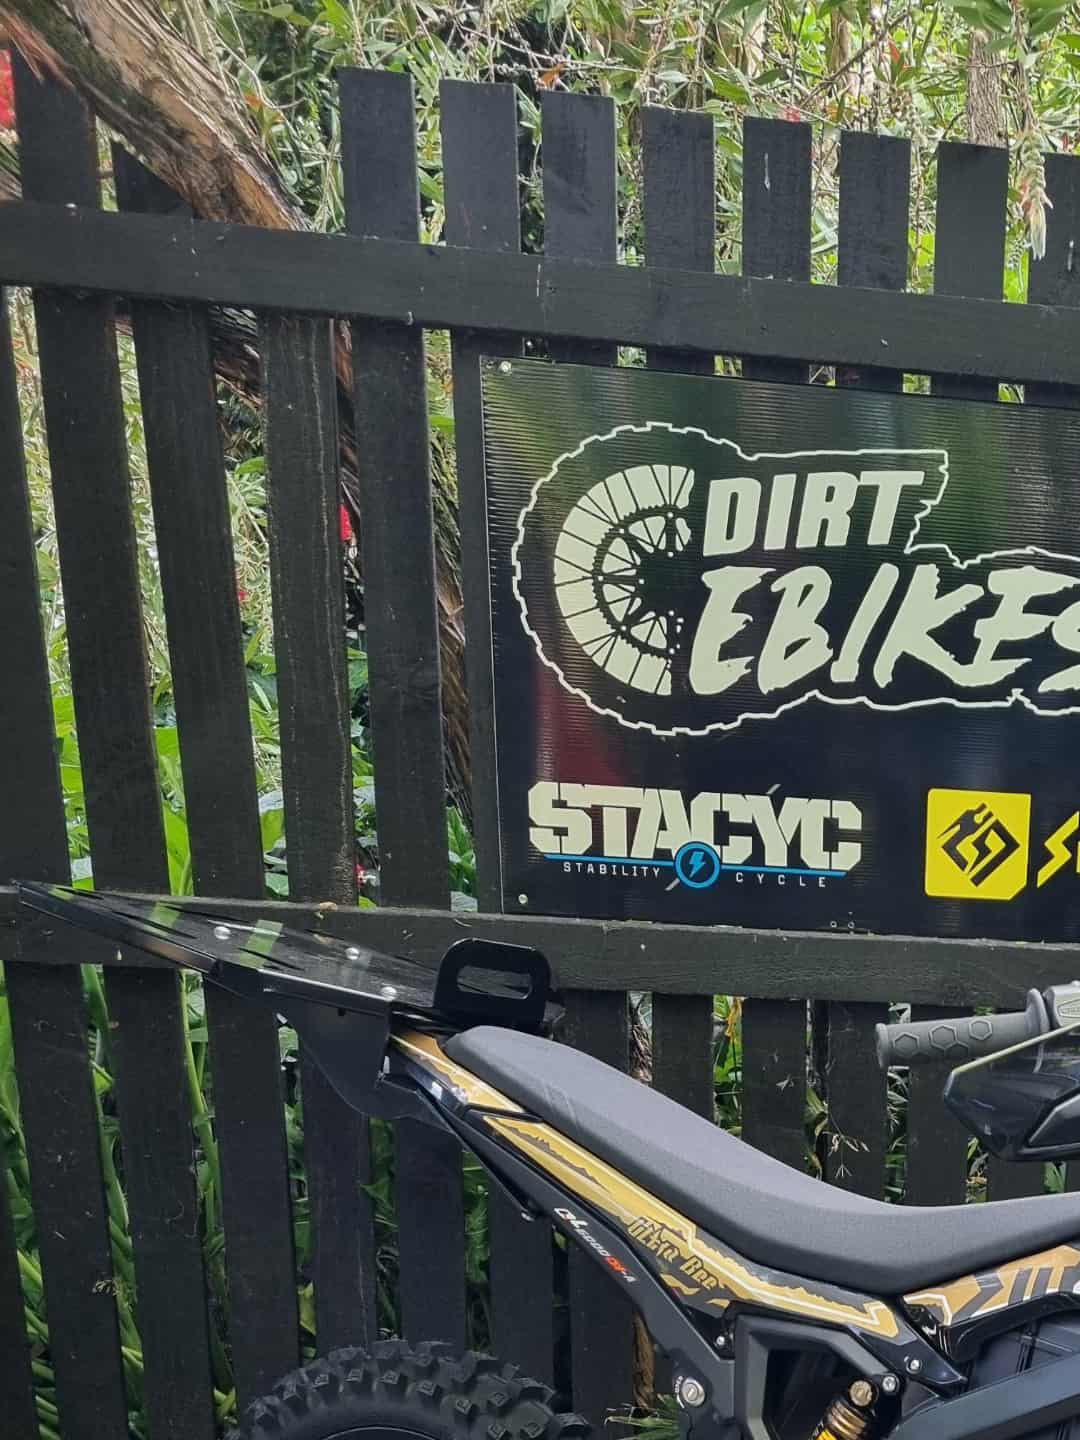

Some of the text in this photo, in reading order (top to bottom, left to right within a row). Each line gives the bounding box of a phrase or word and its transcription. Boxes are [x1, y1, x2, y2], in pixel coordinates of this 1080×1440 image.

[702, 469, 926, 558] DIRT
[527, 780, 863, 871] STACYC
[562, 861, 661, 878] STABILITY
[734, 870, 827, 889] CYCLE
